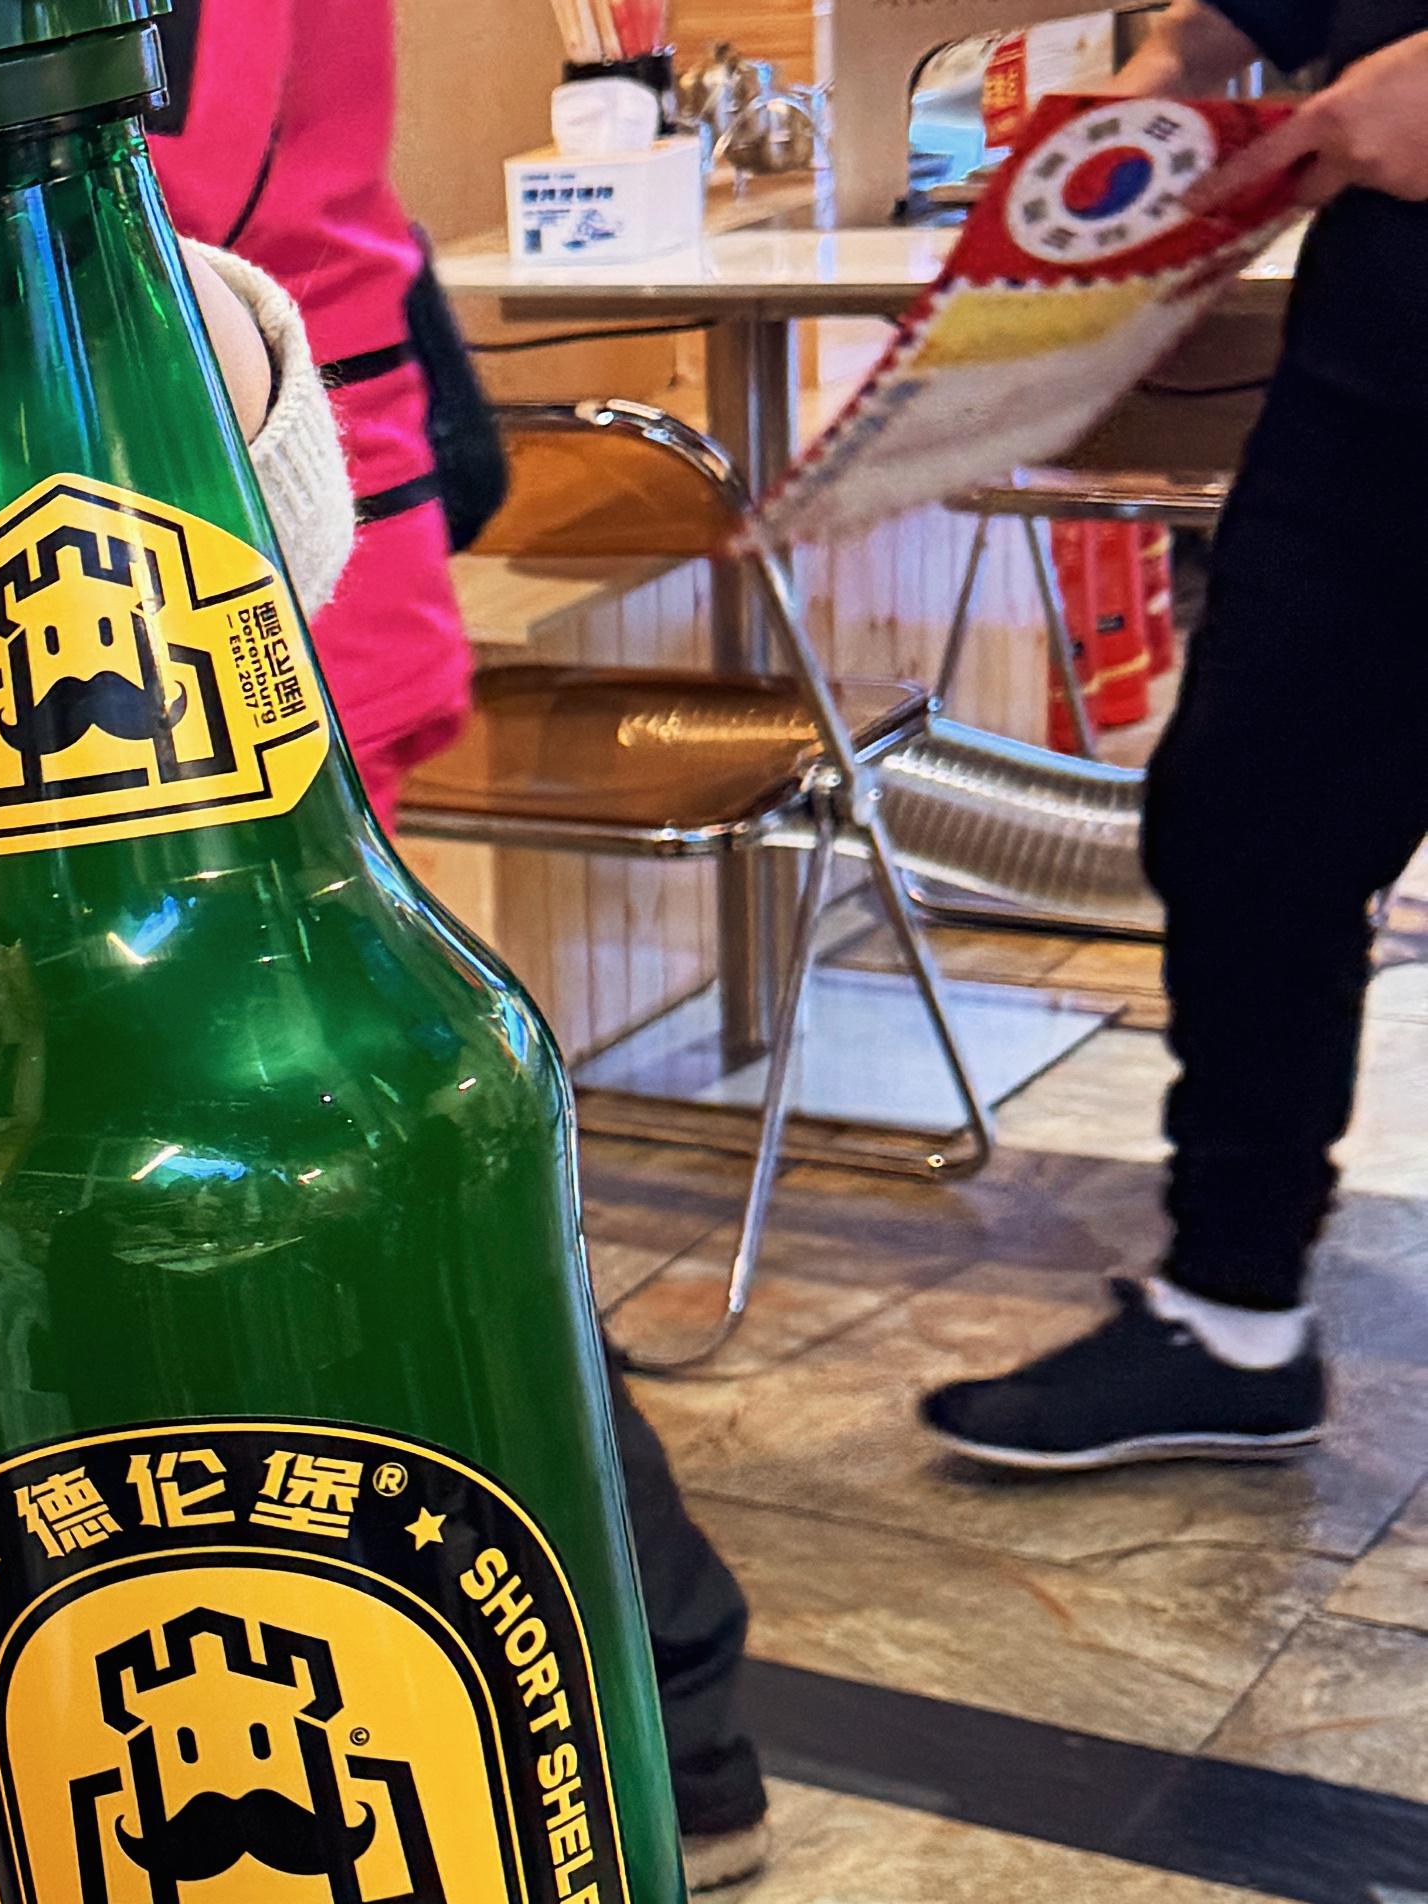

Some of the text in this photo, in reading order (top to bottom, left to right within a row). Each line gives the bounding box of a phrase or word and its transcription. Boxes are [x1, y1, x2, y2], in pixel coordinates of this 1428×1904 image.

[238, 670, 260, 709] 2017
[252, 600, 307, 719] 德伦堡
[459, 1546, 572, 1735] SHORT
